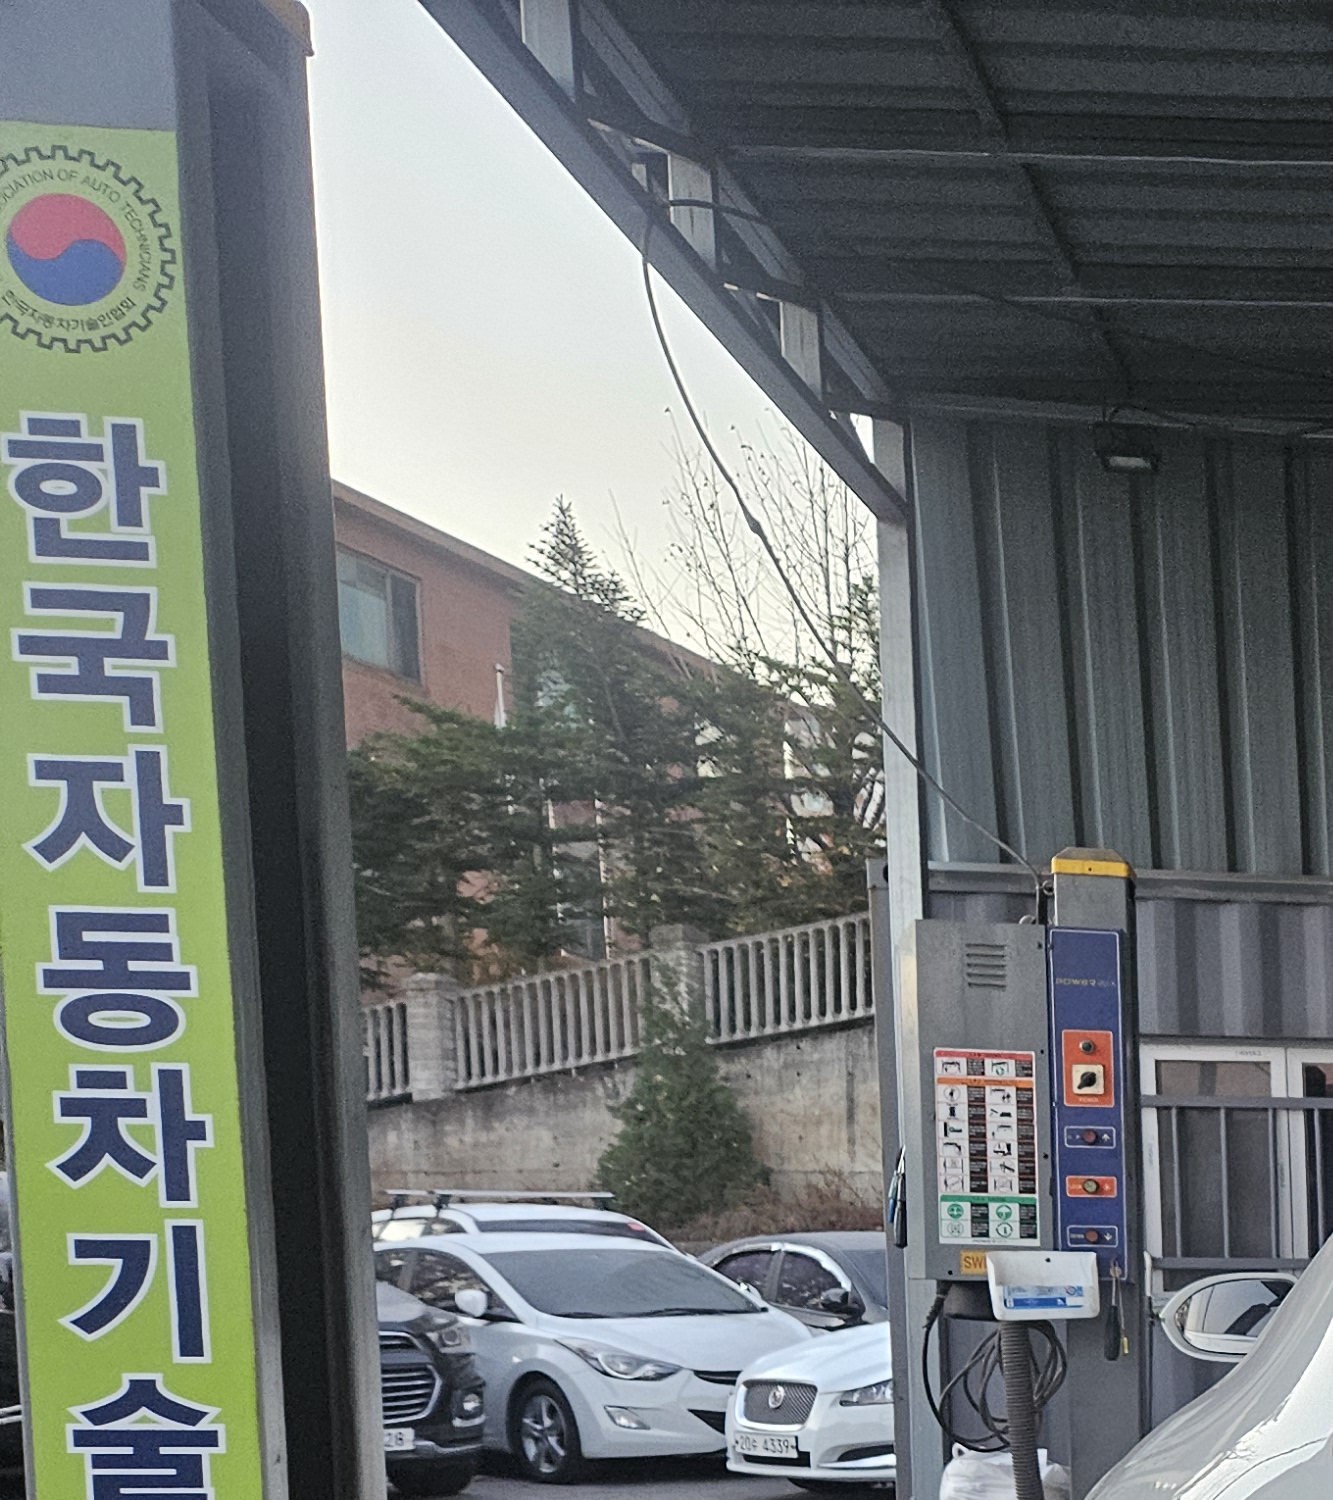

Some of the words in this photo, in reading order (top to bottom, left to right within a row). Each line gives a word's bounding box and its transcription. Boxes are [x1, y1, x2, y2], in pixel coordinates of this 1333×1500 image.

[57, 169, 79, 182] OF
[81, 174, 121, 203] AUTO
[121, 199, 152, 293] TECHNICIANS
[762, 1438, 789, 1454] 4339
